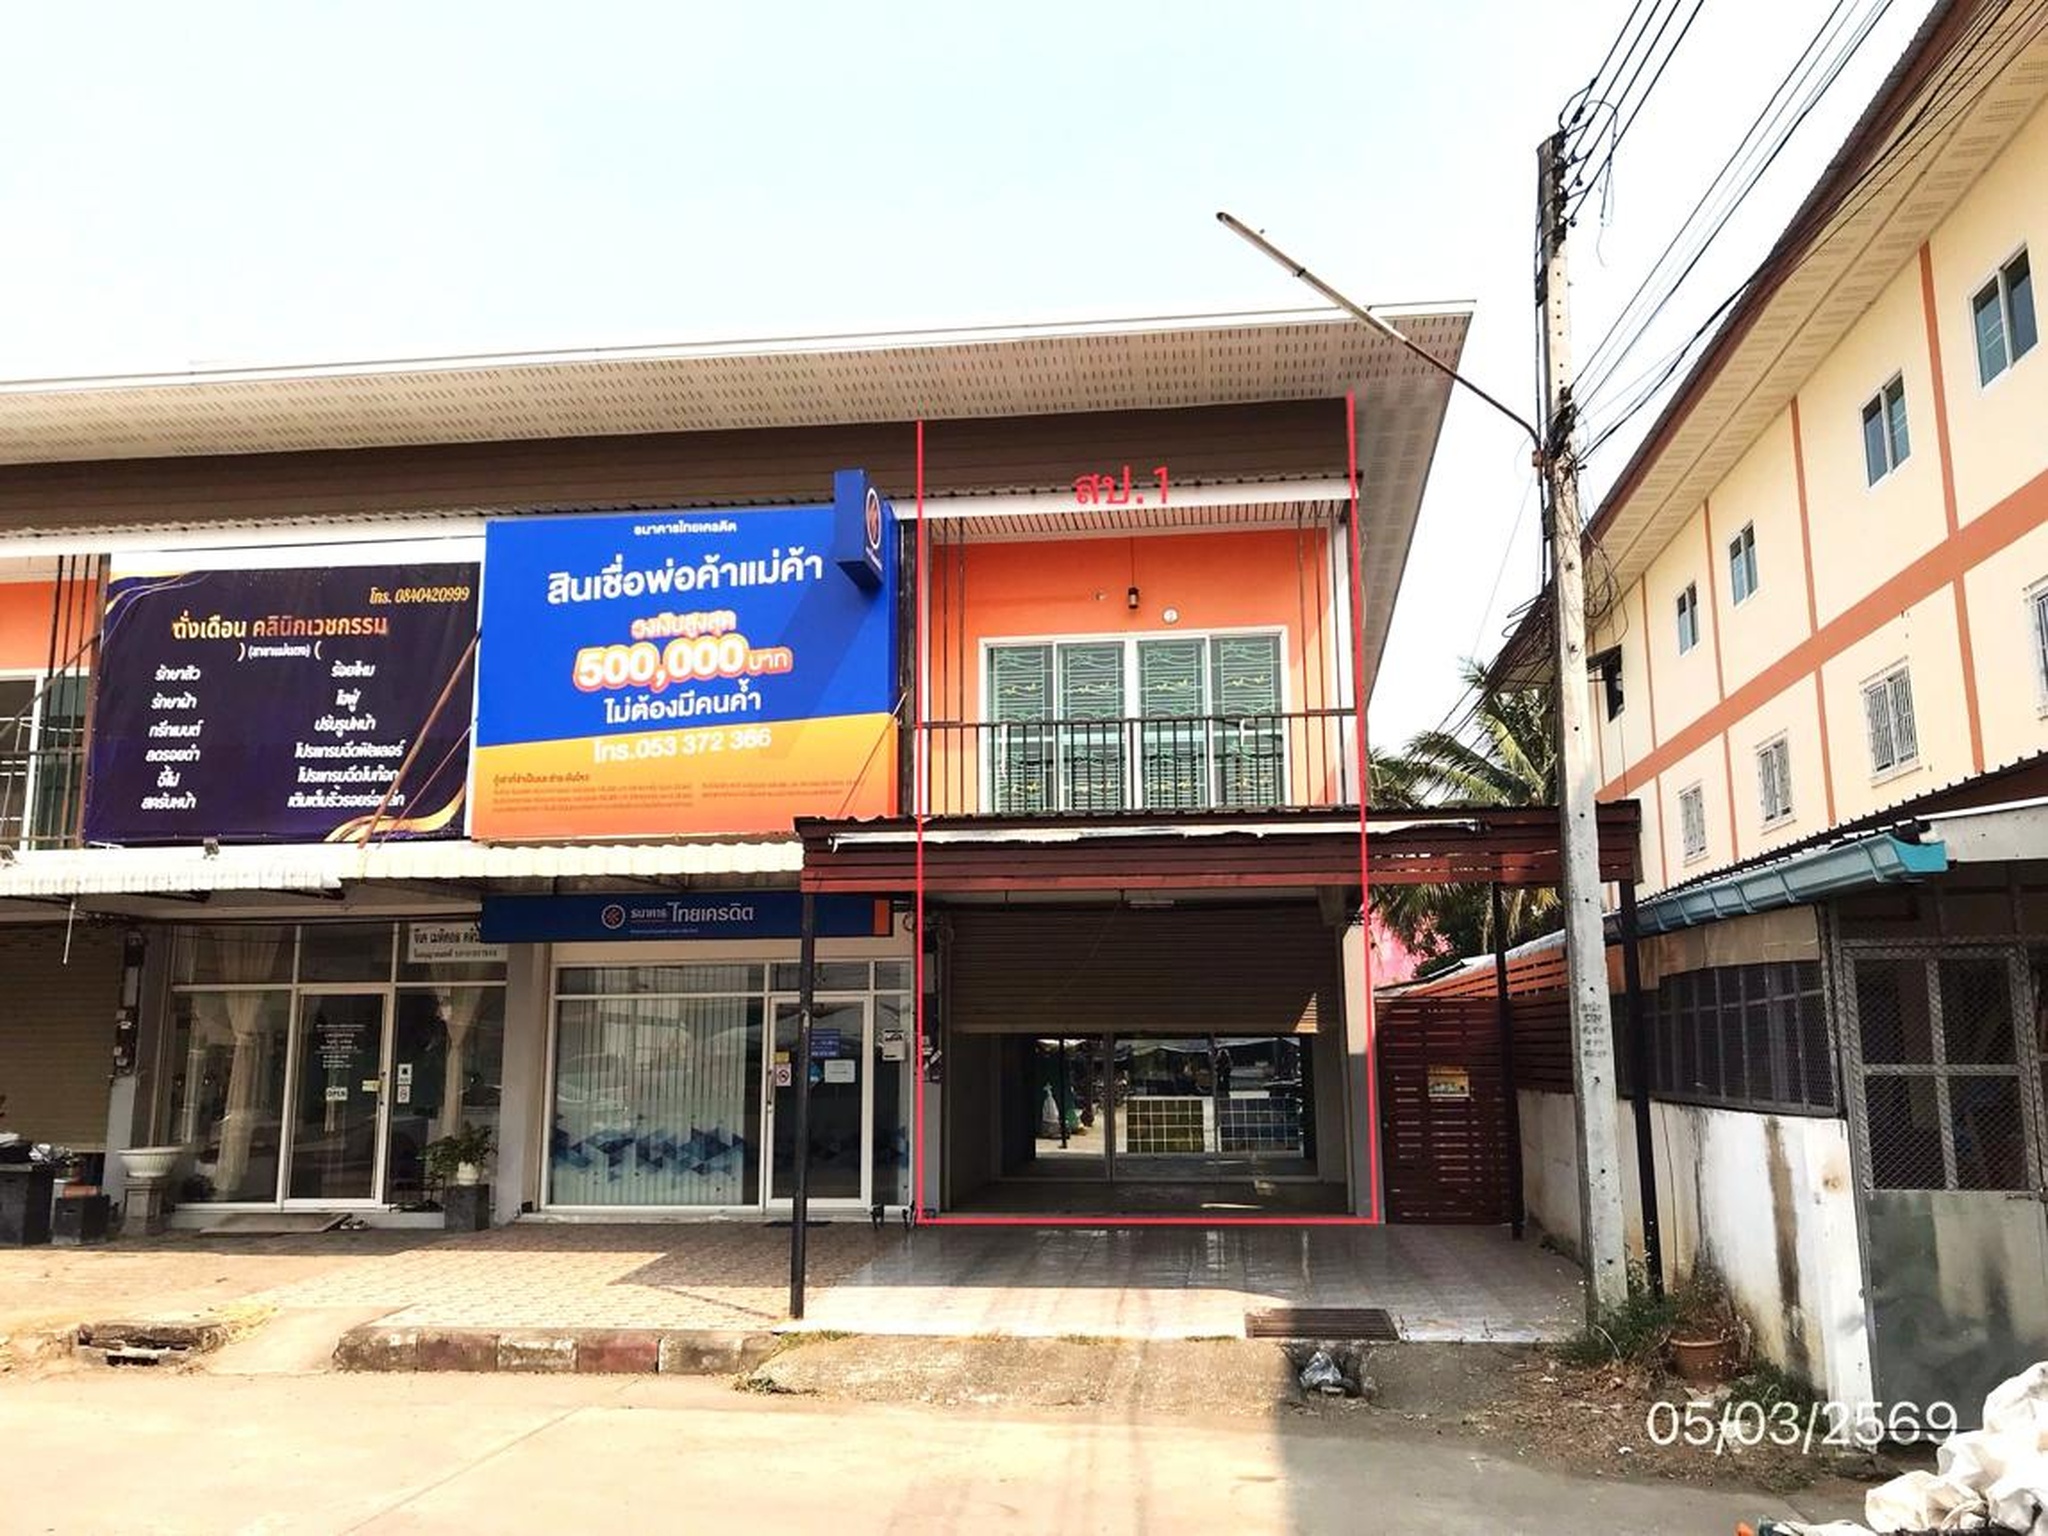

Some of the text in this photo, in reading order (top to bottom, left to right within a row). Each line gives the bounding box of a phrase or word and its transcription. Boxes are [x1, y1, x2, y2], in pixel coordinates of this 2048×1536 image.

[547, 544, 822, 604] สินเชื่อพ่อค้าแม่ค้า
[253, 613, 388, 637] คลินิกเวชกรรม
[576, 637, 790, 689] 500,000 บาท
[605, 678, 762, 724] ไม่ต้องมีคนค้ำ
[682, 732, 725, 756] 372
[667, 900, 754, 923] ไทยเครดิต
